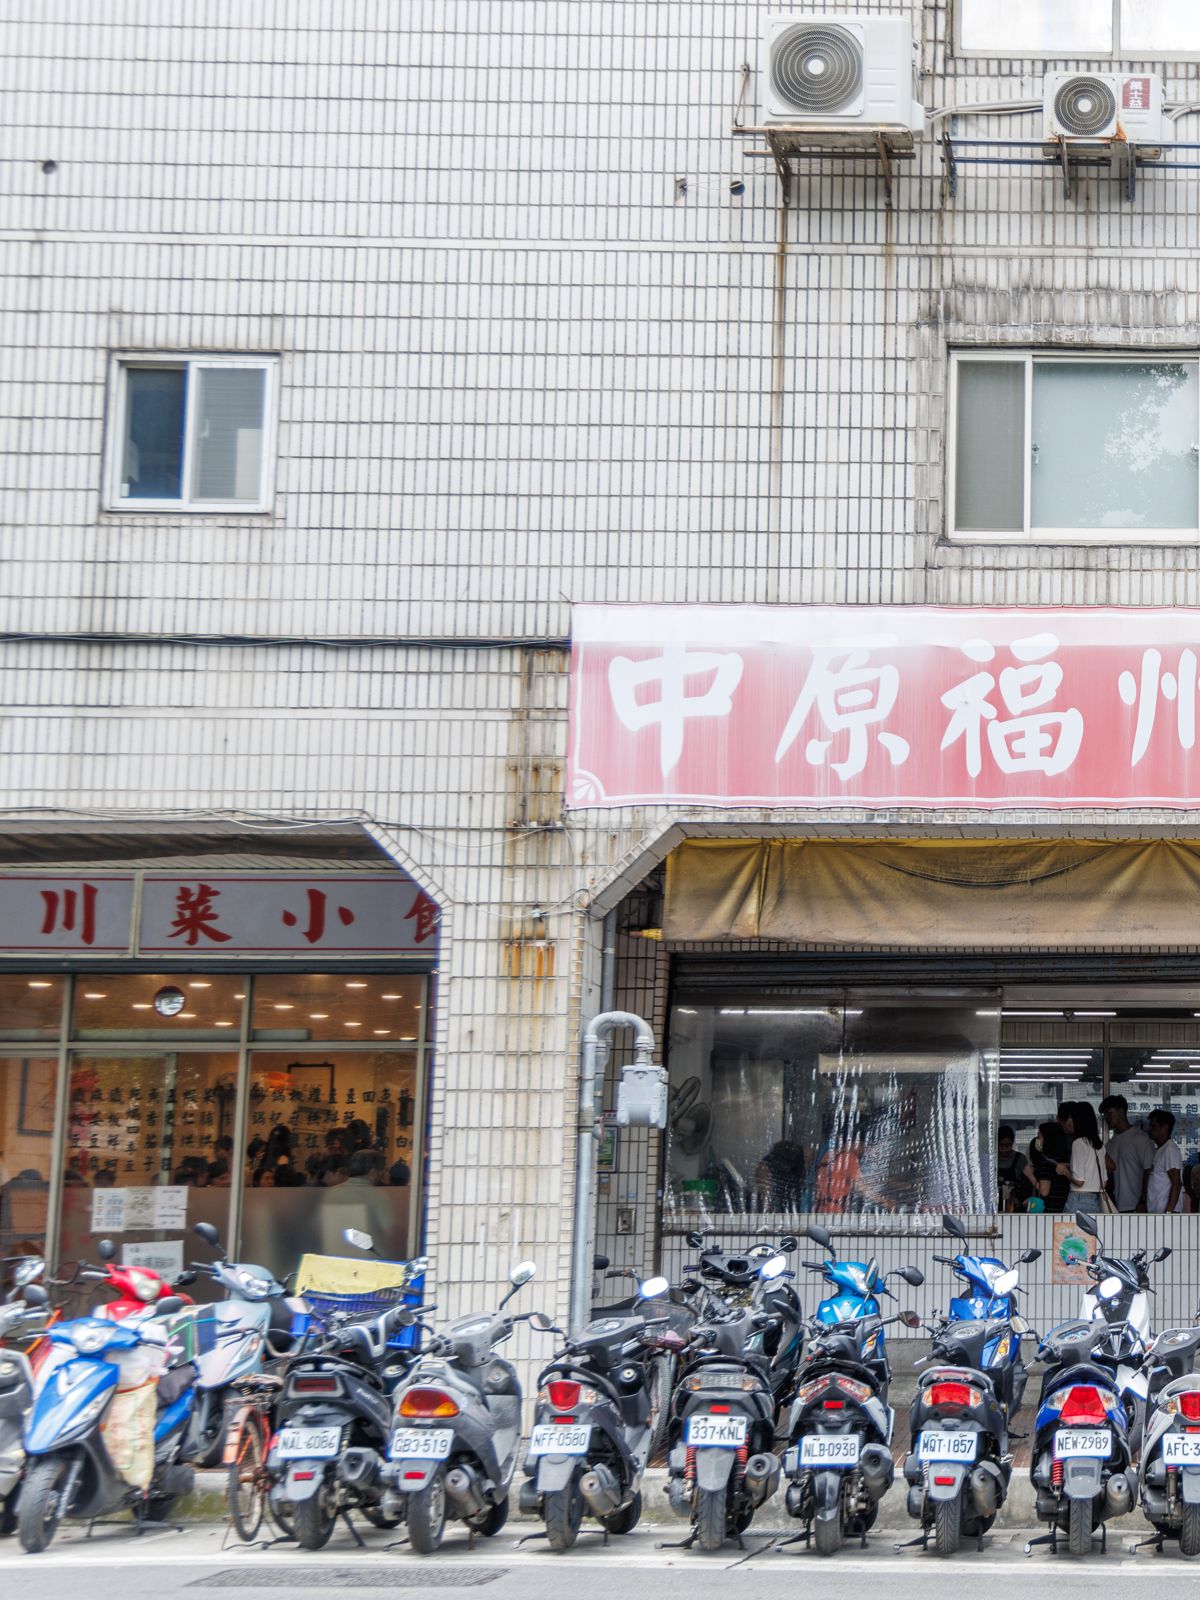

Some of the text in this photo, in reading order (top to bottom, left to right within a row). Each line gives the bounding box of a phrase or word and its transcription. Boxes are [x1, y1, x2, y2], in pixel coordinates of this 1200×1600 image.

[533, 1432, 588, 1447] NFF-0580
[691, 1425, 744, 1441] 337-KNL
[280, 1433, 337, 1450] NAL-6086
[393, 1438, 448, 1453] GB3-519
[1057, 1436, 1109, 1451] NEW-2989
